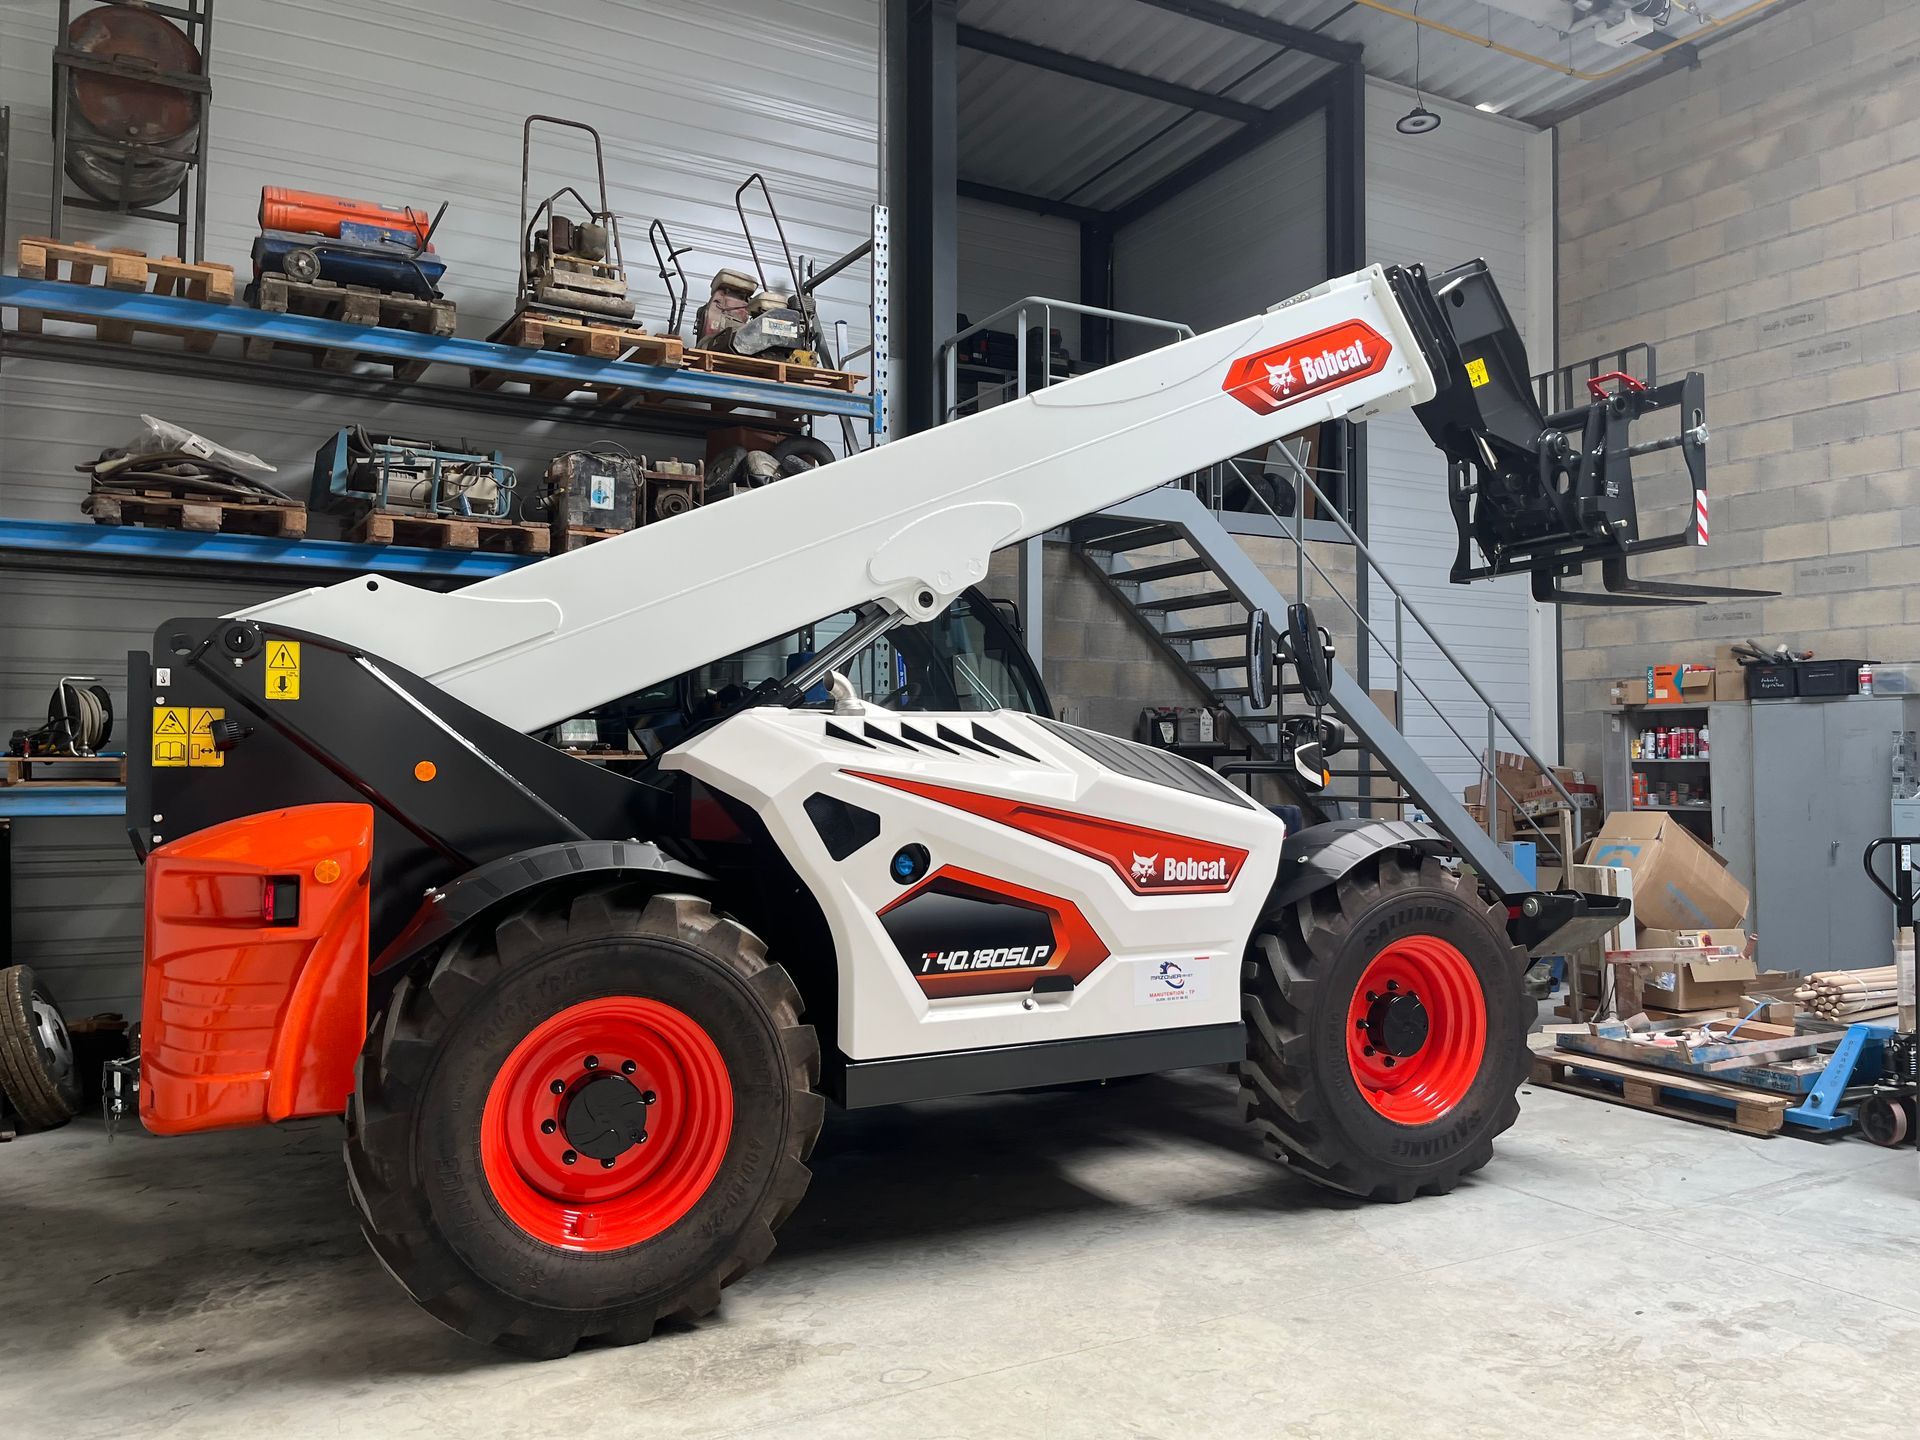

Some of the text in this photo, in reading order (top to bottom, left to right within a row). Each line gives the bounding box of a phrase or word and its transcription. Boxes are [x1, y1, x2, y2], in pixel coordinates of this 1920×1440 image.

[1299, 339, 1367, 385] Bobcat
[1163, 857, 1226, 881] Bobcat
[1378, 905, 1455, 938] ALLIANCE
[921, 945, 1050, 973] T40.180SLP
[1149, 990, 1184, 998] MANUTENTION
[1390, 1115, 1468, 1158] ALLIANCE
